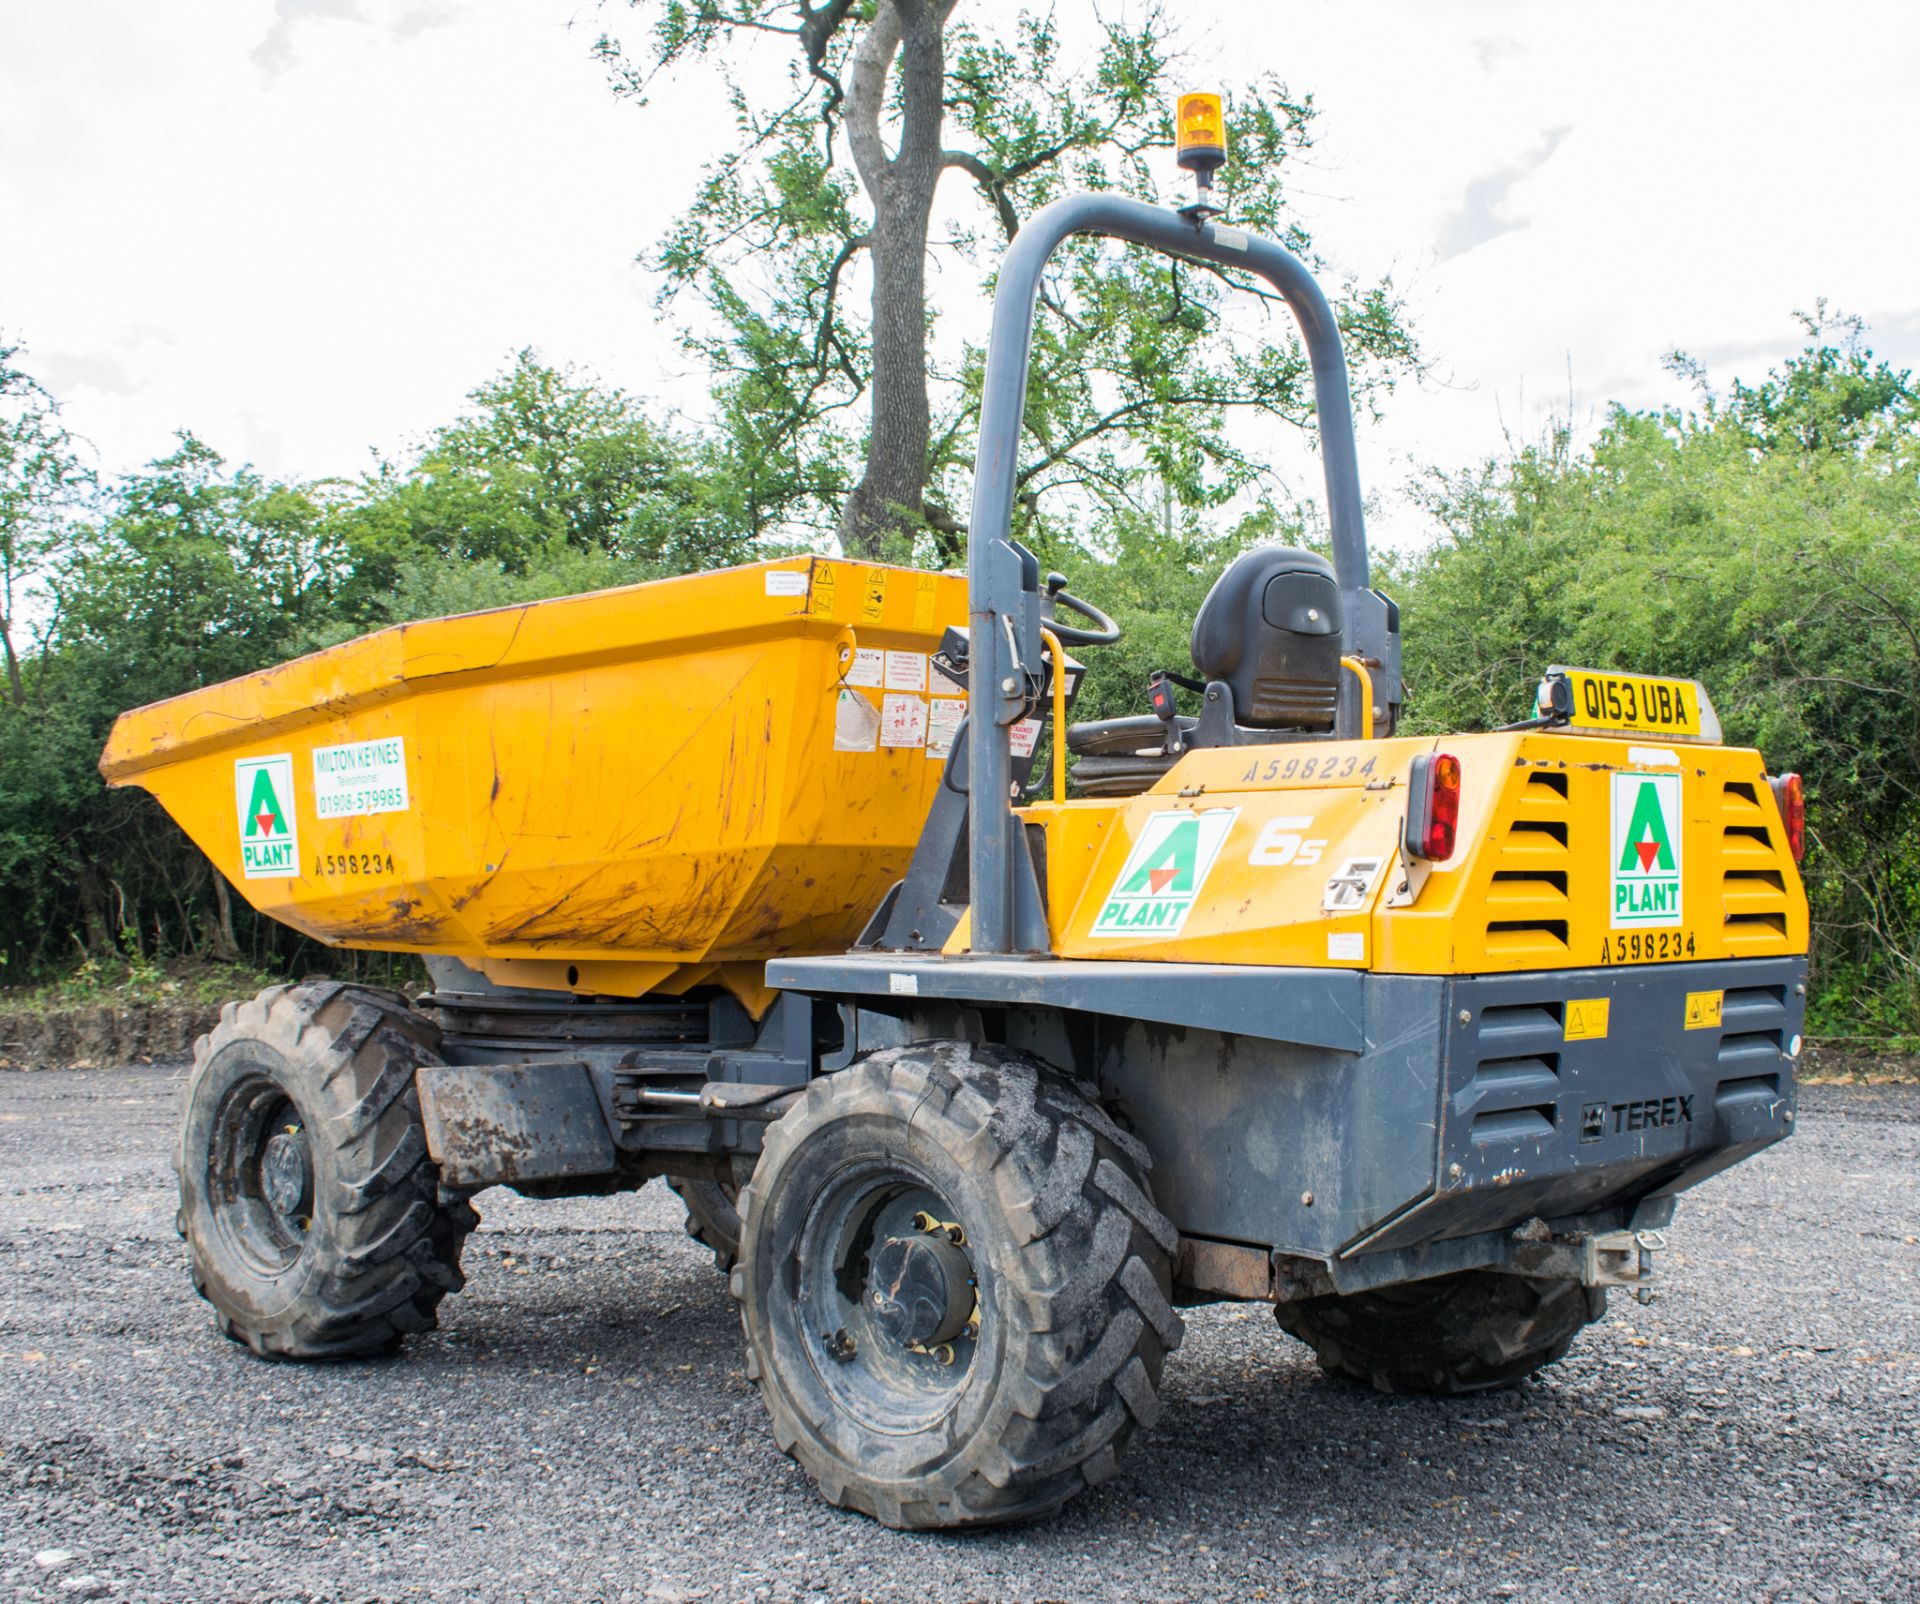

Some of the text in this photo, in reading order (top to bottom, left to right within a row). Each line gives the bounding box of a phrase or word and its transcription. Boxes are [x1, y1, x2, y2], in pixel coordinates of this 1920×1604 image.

[1641, 684, 1688, 725] UBA
[317, 743, 399, 773] MILTON KEYNES
[1242, 755, 1378, 783] A598234
[245, 769, 288, 837] A
[320, 788, 402, 813] 01908-579985
[1619, 782, 1676, 871] A
[244, 843, 292, 867] PLANT
[315, 854, 394, 876] A598234
[1119, 820, 1200, 892] A
[1616, 883, 1679, 913] PLANT
[1098, 902, 1188, 927] PLANT
[1601, 932, 1696, 964] A598234
[1611, 1094, 1694, 1134] TEREX
